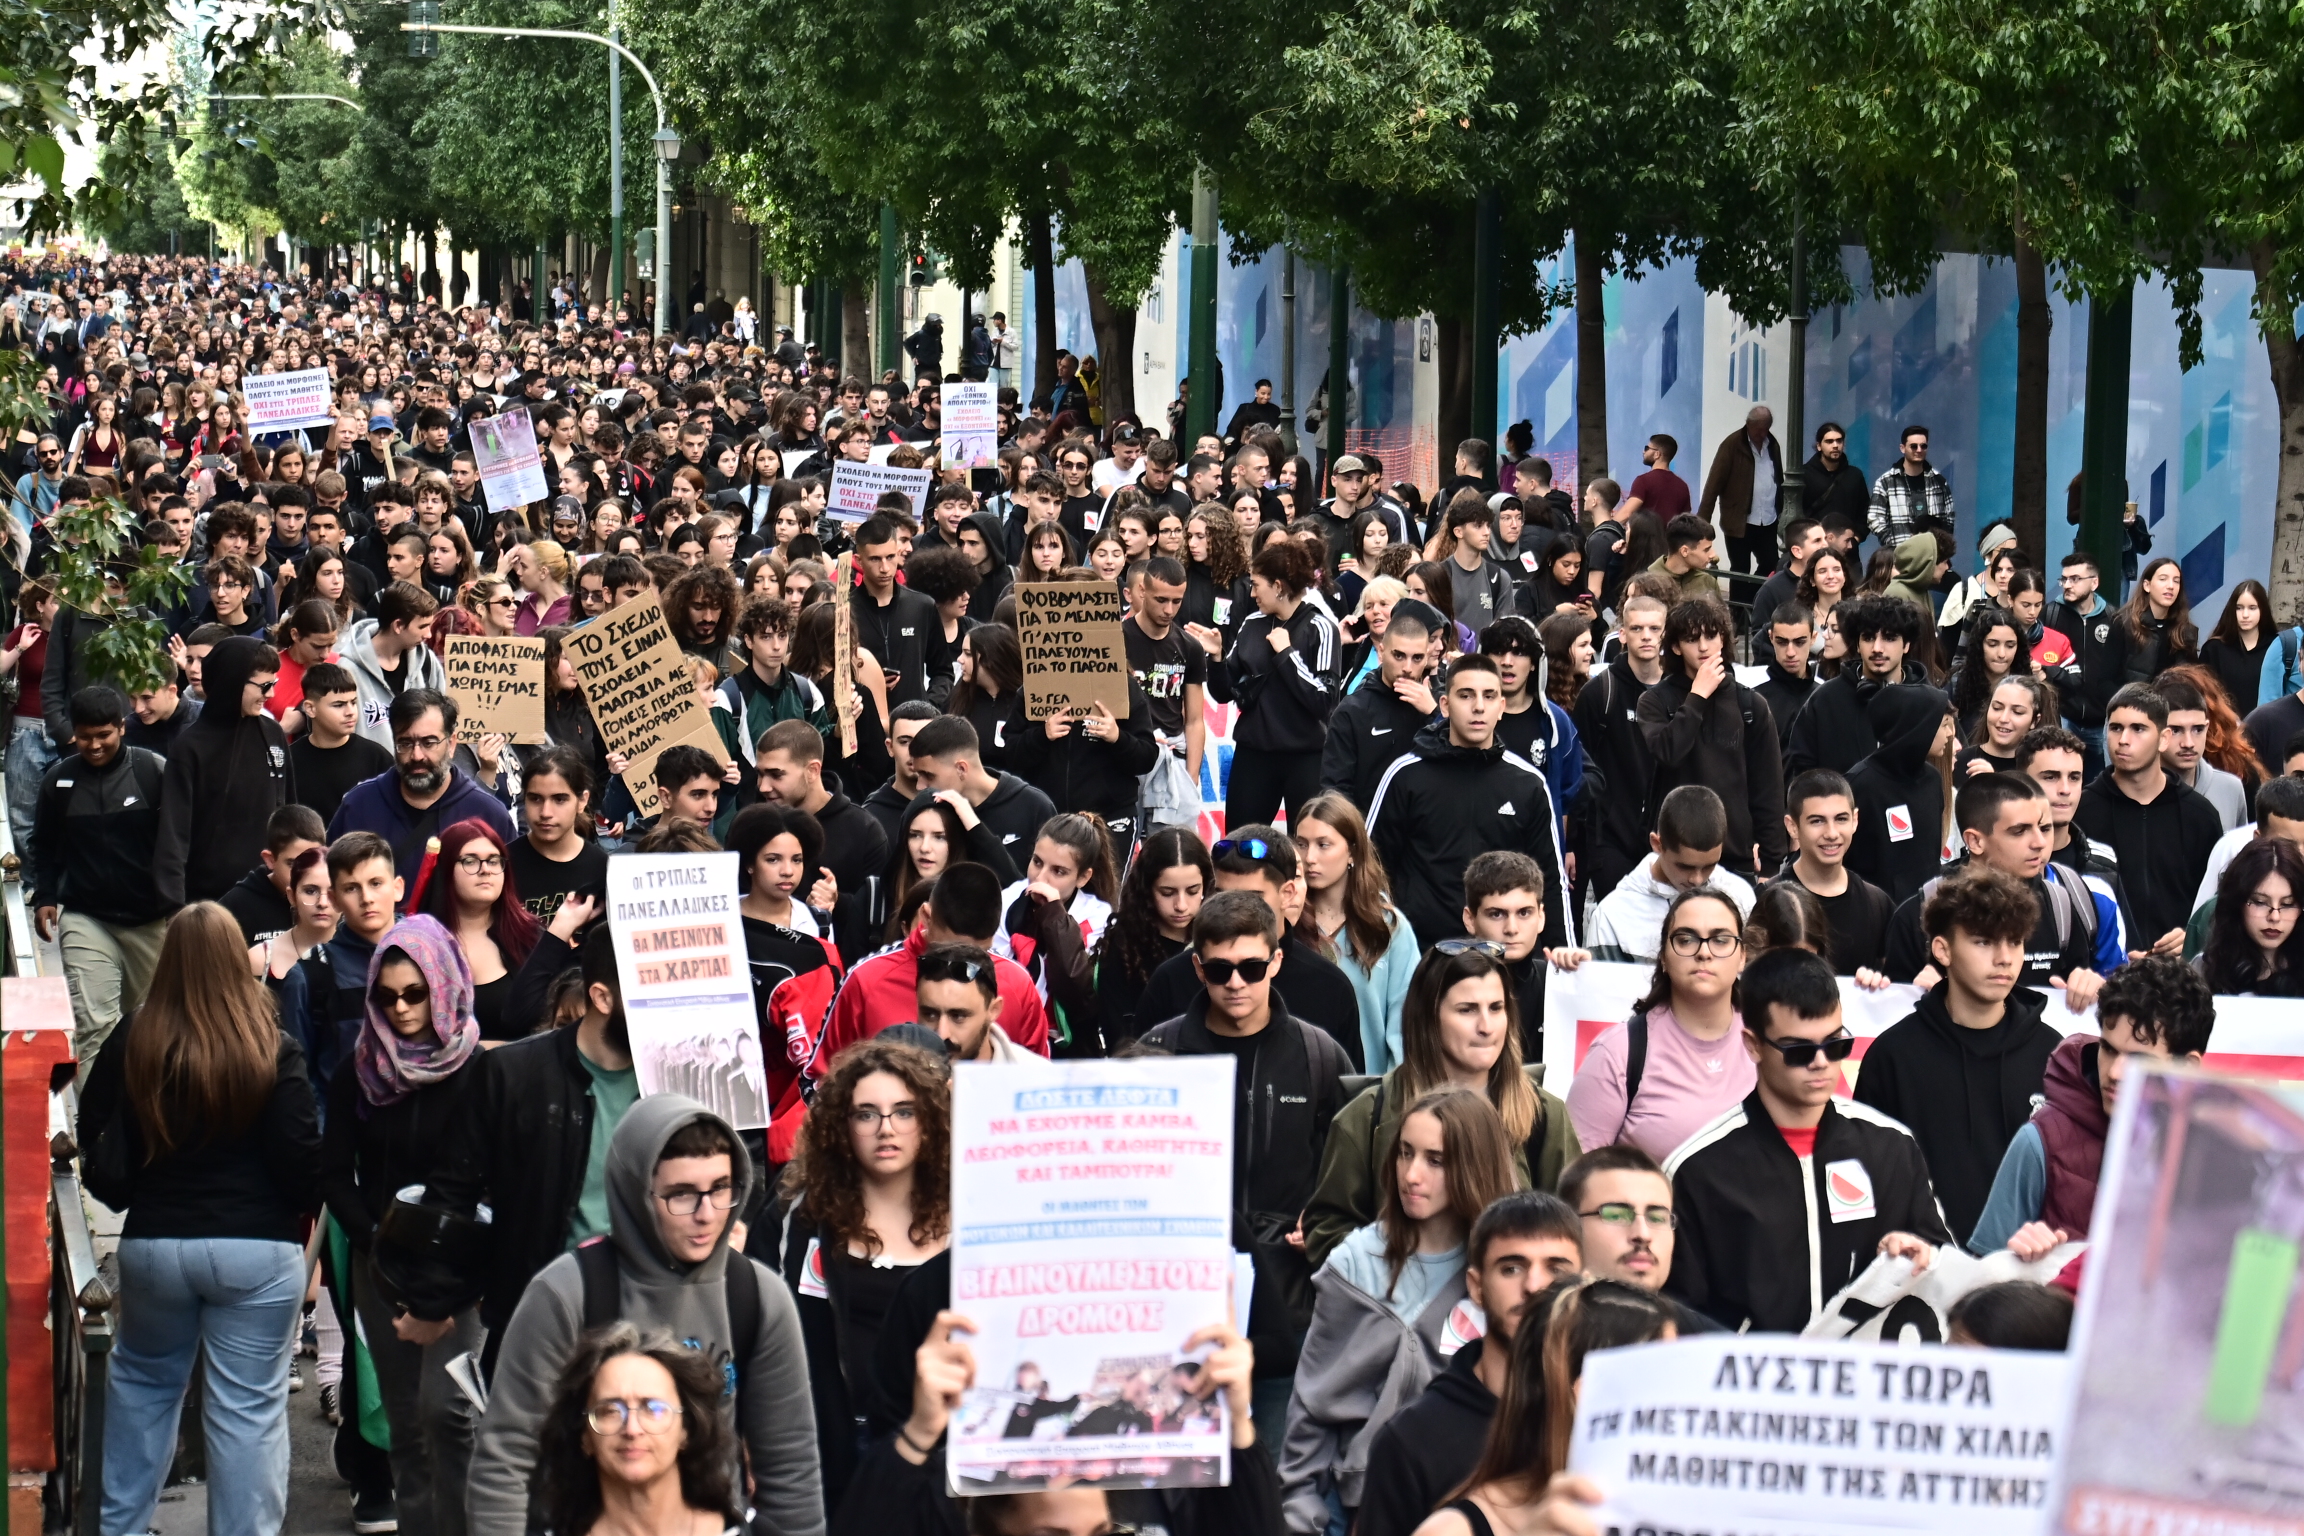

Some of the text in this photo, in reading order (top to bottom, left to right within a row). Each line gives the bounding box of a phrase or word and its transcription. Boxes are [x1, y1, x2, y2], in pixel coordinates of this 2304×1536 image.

[245, 380, 275, 390] ΣΧΟΛΕΙΟ
[286, 374, 325, 385] ΜΟΡΦΩΝΕΙ
[248, 384, 324, 400] ΟΛΟΥΣ ΤΟΥΣ ΜΑΘΗΤΕΣ
[253, 394, 321, 410] ΟΧΙ ΣΤΙΣ ΤΡΙΠΛΕΣ
[257, 405, 320, 419] ΠΑΝΕΛΛΑΔΙΚΕΣ
[836, 466, 871, 478] ΣΧΟΛΕΙΟ
[883, 473, 927, 483] ΜΟΡΦΩΝΕΙ
[836, 477, 923, 493] ΟΛΟΥΣ ΤΟΥΣ ΜΑΘΗΤΕΣ
[840, 488, 855, 497] ΟΧΙ
[856, 492, 875, 500] ΣΤΙΣ
[1019, 610, 1120, 628] ΓΙΑ ΤΟ ΜΕΛΛΟΝ
[568, 605, 661, 658] ΤΟ ΣΧΕΔΙΟ
[449, 641, 546, 661] ΑΠΟΦΑΣΙΖΟΥΝ
[576, 625, 668, 681] ΤΟΥΣ ΕΙΝΑΙ
[1025, 646, 1110, 660] ΠΑΛΕΥΟΥΜΕ
[448, 658, 519, 676] ΓΙΑ ΕΜΑΣ
[668, 664, 690, 683] ΜΕ
[1026, 661, 1123, 675] ΓΙΑ ΤΟ ΠΑΡΟΝ.
[497, 680, 539, 697] ΕΜΑΣ
[587, 660, 652, 702] ΣΧΟΛΕΙΑ
[1046, 693, 1070, 705] ΓΕΛ
[601, 680, 697, 738] ΓΟΝΕΙΣ ΠΕΛΑΤΕΣ
[463, 718, 486, 729] ΓΕΛ
[608, 735, 627, 752] ΚΑΙ
[632, 867, 708, 891] ΟΙ ΤΡΙΠΛΕΣ
[617, 894, 730, 922] ΠΑΝΕΛΛΑΔΙΚΕΣ
[253, 930, 285, 942] ATHLET
[632, 926, 724, 954] ΘΑ ΜΕΙΝΟΥΝ
[638, 957, 729, 986] ΣΤΑ ΧΑΡΤΙΑ!
[1019, 1087, 1173, 1111] ΔΩΣΤΕ ΛΕΦΤΑ
[989, 1118, 1021, 1136] ΝΑ
[1026, 1113, 1115, 1134] ΕΧΟΥΜΕ
[963, 1138, 1223, 1164] ΛΕΩΦΟΡΕΙΑ, ΚΑΘΗΓΗΤΕΣ
[1016, 1163, 1174, 1184] ΚΑΙ ΤΑΜΠΟΥΡΑ!
[1016, 1301, 1164, 1338] ΔΡΟΜΟΥΣ
[1712, 1353, 1995, 1409] ΛΥΣΤΕ ΤΩΡΑ
[1586, 1406, 2053, 1460] ΤΗ ΜΕΤΑΚΙΝΗΣΗ ΤΩΝ ΧΙΛΙΑ
[1626, 1451, 1808, 1496] ΜΑΘΗΤΩΝ
[1818, 1465, 1889, 1501] ΤΗΣ
